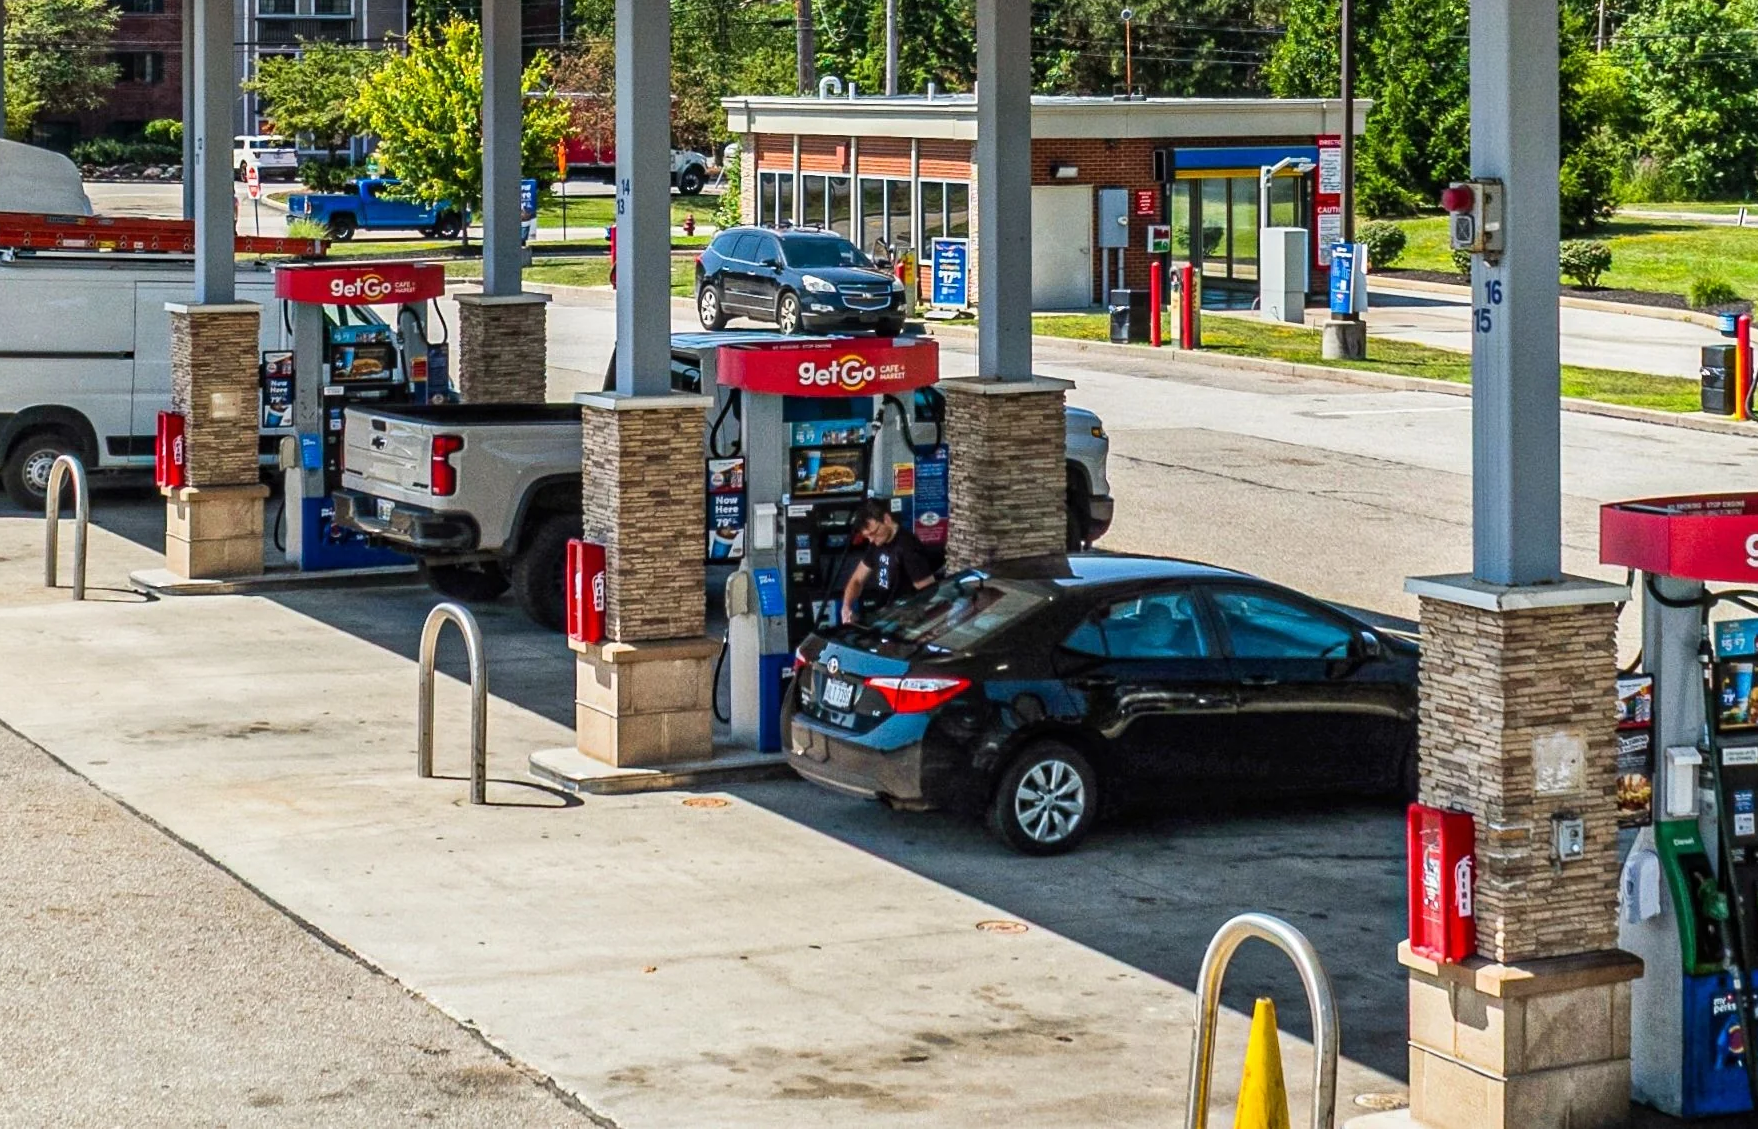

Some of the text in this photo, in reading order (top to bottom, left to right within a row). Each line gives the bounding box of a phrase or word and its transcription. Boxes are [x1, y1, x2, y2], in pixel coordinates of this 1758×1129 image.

[621, 179, 630, 196] 14
[617, 199, 624, 215] 13
[1317, 206, 1342, 215] CAUTI
[331, 278, 392, 298] getGo
[1485, 280, 1503, 305] 16
[1474, 308, 1492, 333] 15
[798, 360, 876, 386] getGo
[880, 364, 898, 373] CAFE
[879, 371, 905, 380] MARKET
[715, 496, 739, 505] Now
[715, 505, 739, 514] Here
[1713, 1003, 1737, 1014] perks
